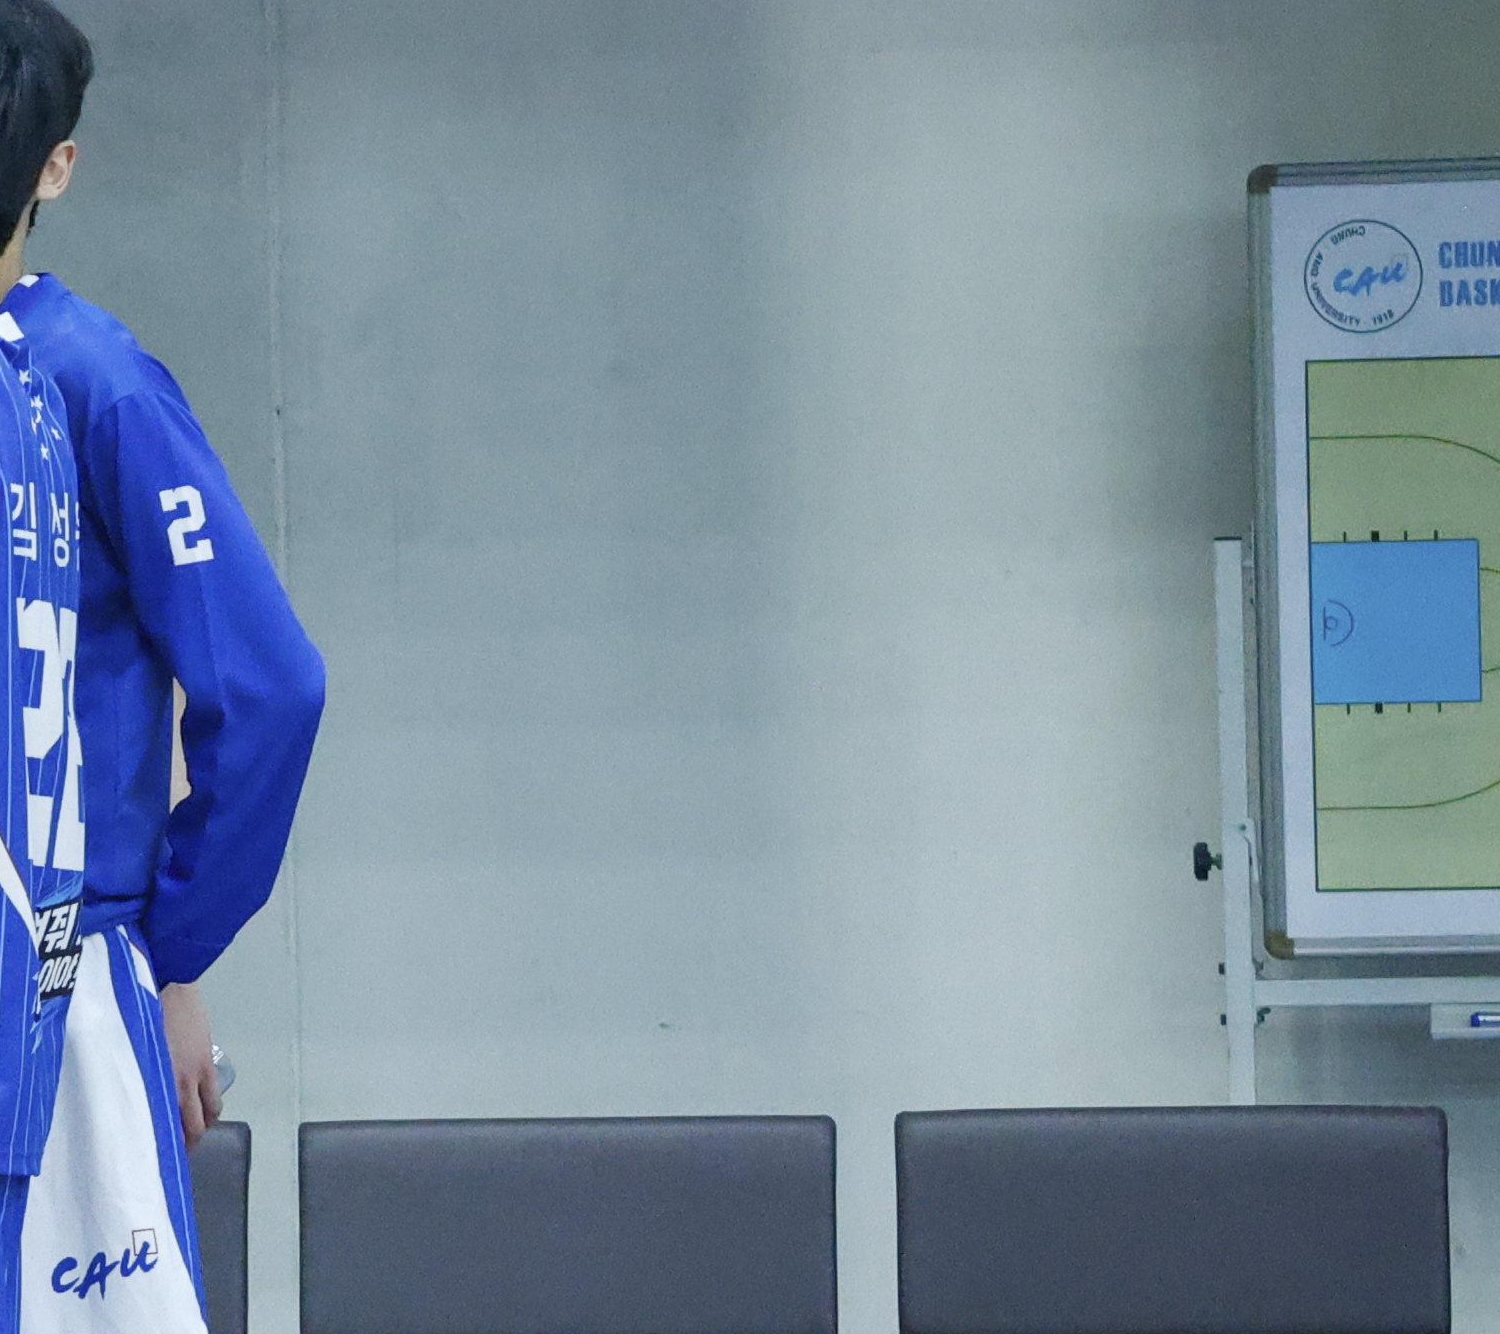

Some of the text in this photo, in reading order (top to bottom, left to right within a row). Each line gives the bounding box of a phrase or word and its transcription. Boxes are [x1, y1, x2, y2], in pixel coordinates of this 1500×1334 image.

[10, 482, 80, 571] 김정
[159, 485, 214, 566] 2
[51, 1241, 159, 1299] CAU
